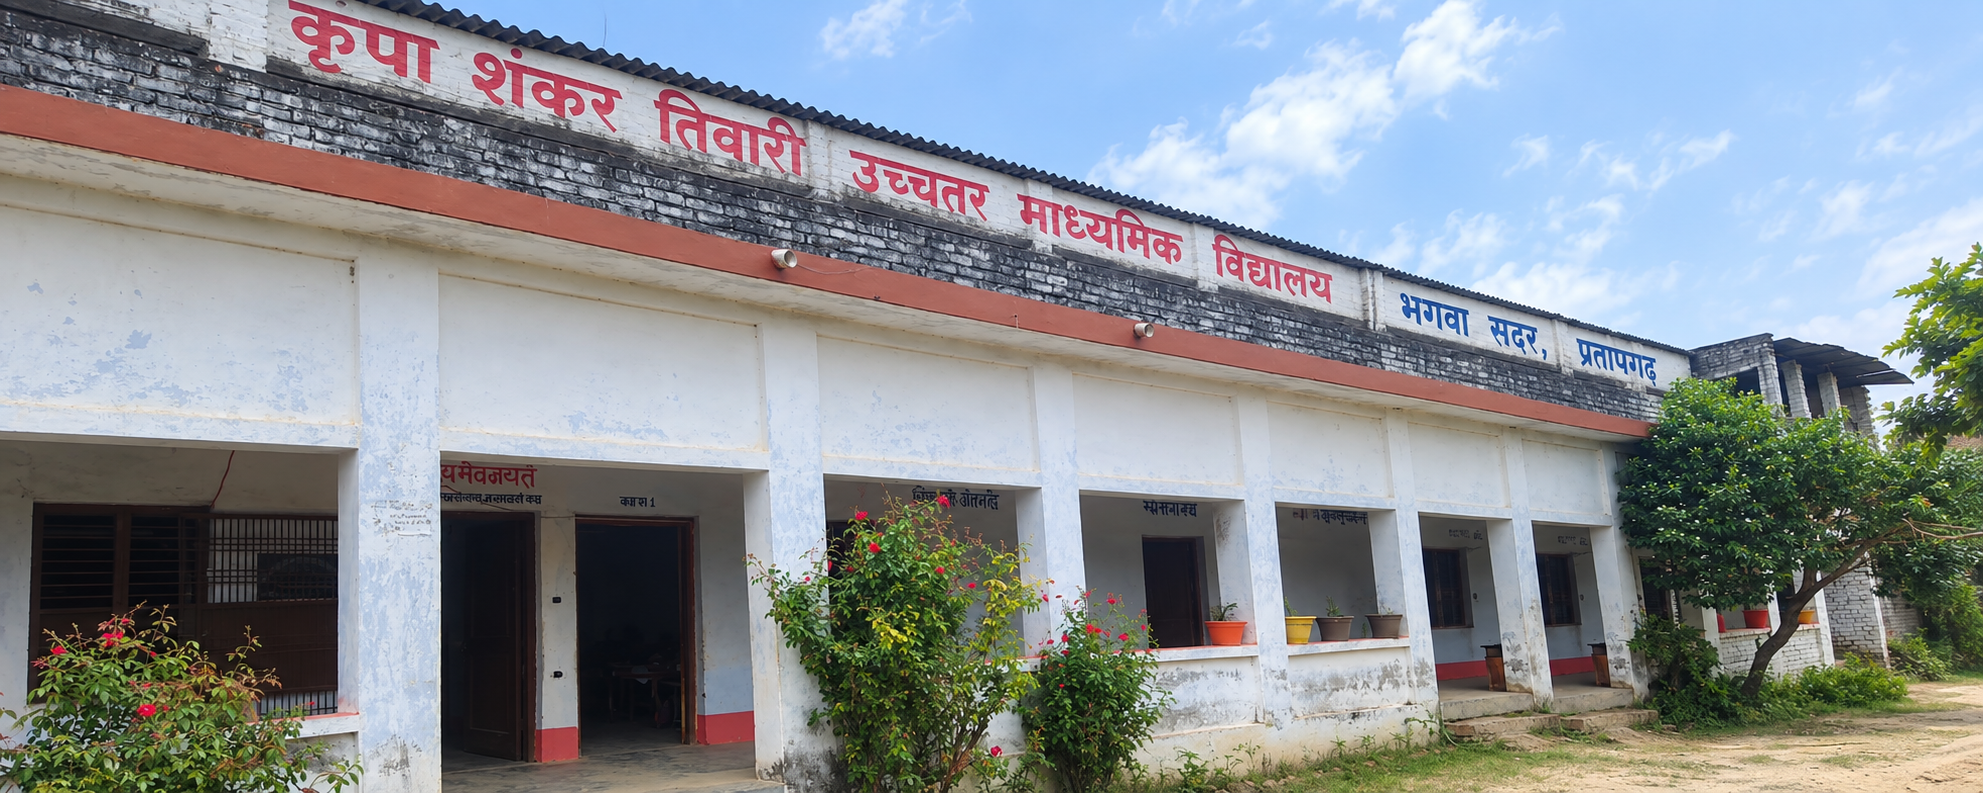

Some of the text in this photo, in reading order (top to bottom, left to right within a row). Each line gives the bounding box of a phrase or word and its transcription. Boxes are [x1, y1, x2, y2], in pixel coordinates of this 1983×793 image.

[288, 0, 440, 84] कृपा
[472, 48, 623, 133] शंकर
[654, 89, 807, 176] तिवारी
[849, 150, 990, 222] उच्चतर
[1017, 193, 1184, 265] माध्यमिक
[1213, 234, 1332, 304] विद्यालय
[1400, 292, 1470, 337] भगवा
[1487, 315, 1547, 361] सदर,
